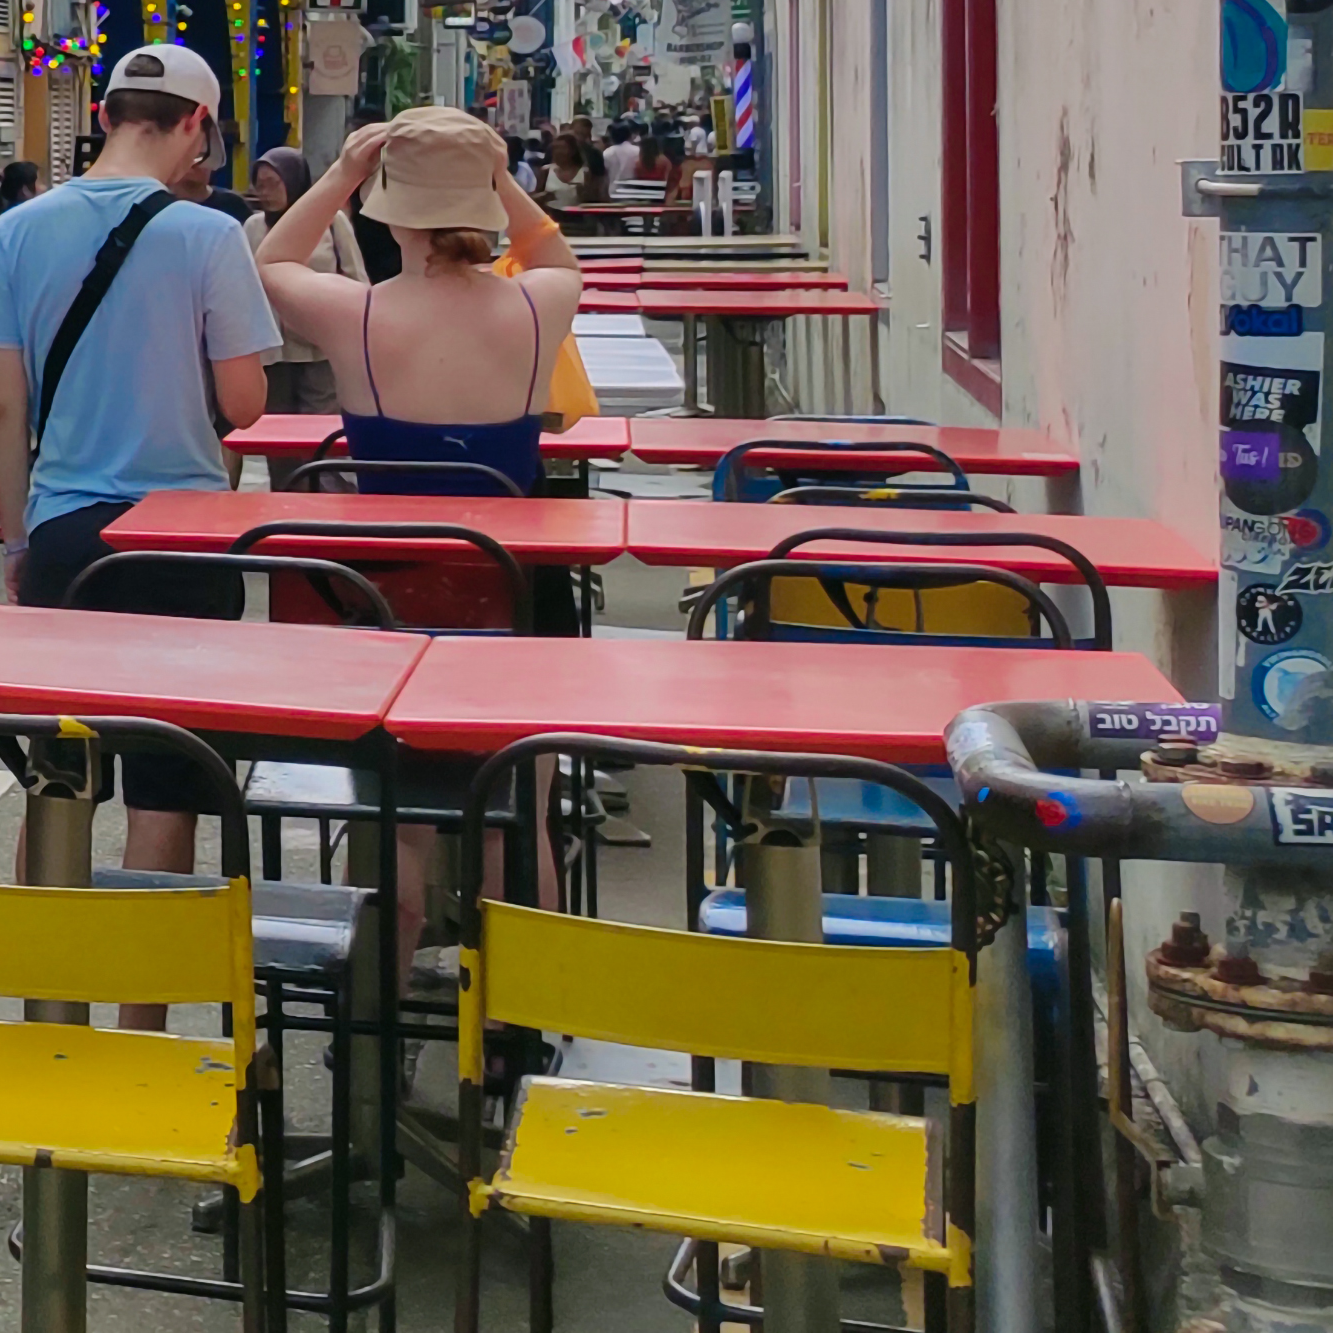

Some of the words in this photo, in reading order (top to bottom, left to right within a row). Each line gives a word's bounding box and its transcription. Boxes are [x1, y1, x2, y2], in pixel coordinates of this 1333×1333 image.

[1220, 269, 1305, 302] GUY
[1232, 389, 1283, 409] WAS
[1096, 712, 1140, 729] טוב
[1145, 710, 1218, 736] תקבל
